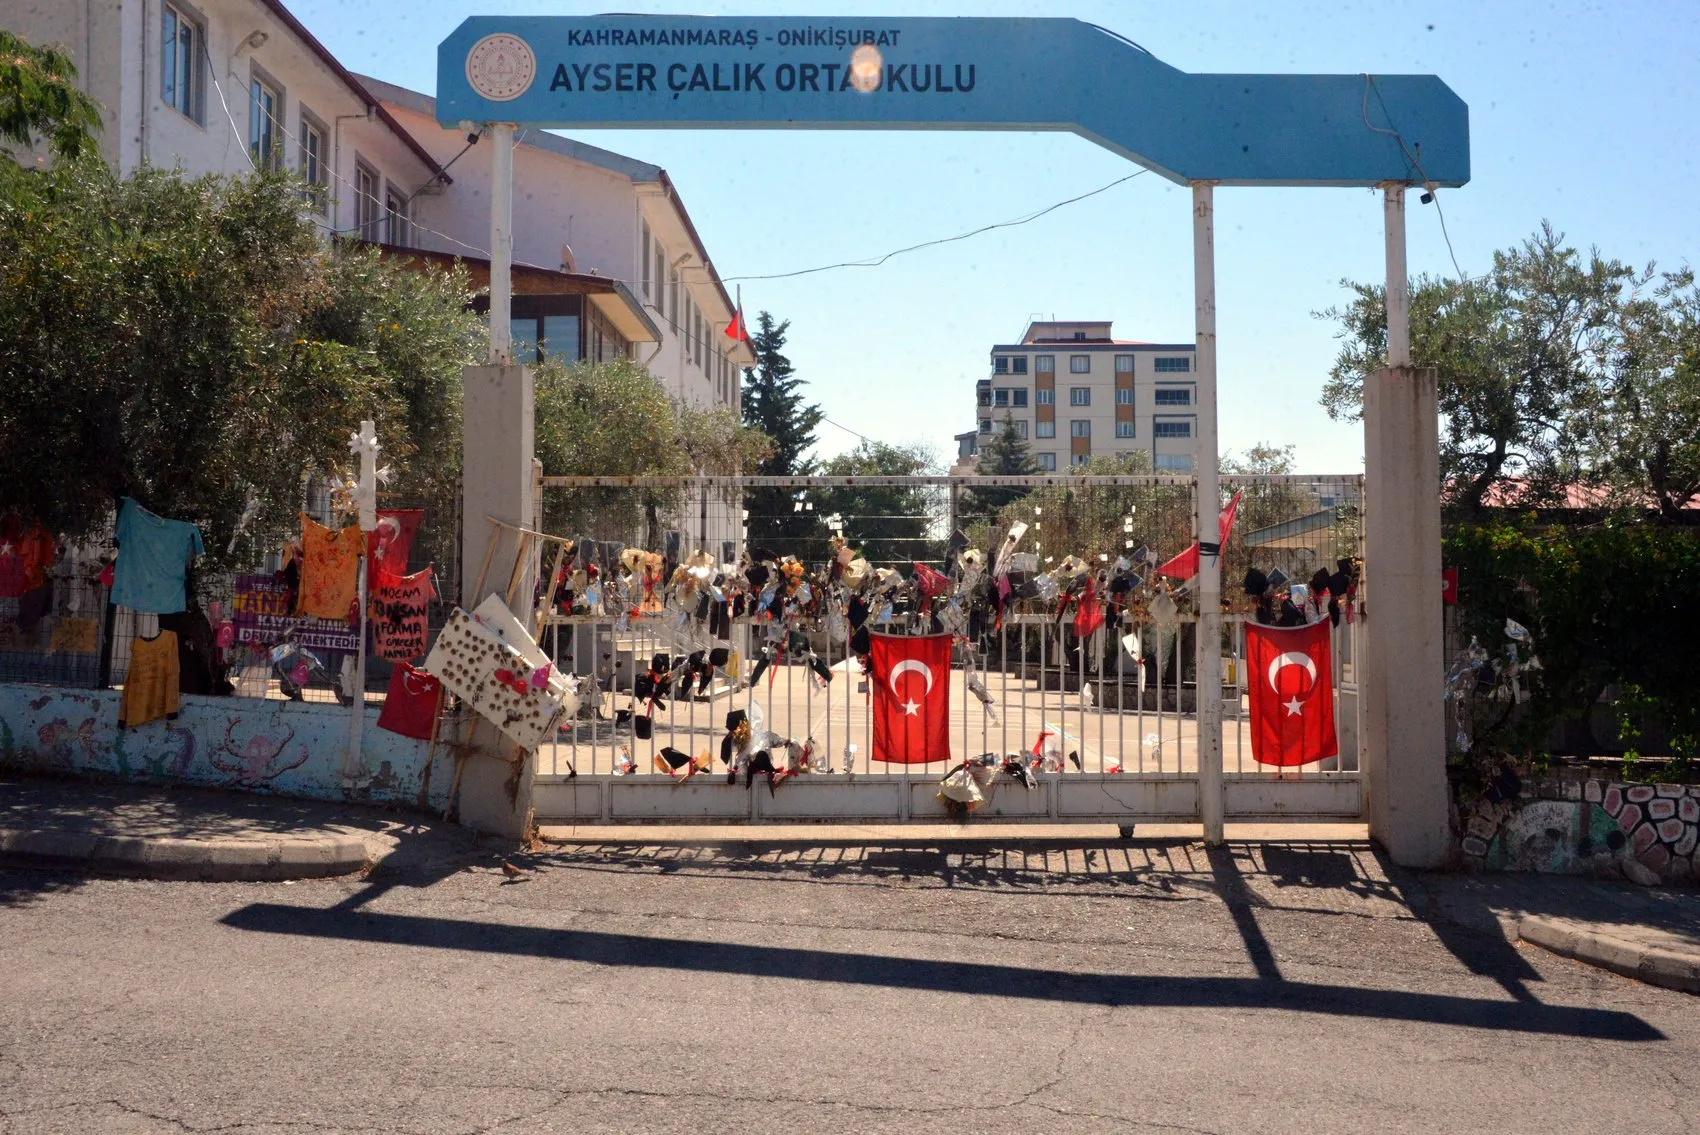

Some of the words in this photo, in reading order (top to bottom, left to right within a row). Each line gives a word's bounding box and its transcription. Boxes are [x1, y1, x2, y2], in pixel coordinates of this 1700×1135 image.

[567, 29, 759, 50] KAHRAMANMARAŞ
[777, 25, 901, 50] ONİKİŞUBAT
[549, 62, 657, 92] AYSER
[667, 62, 767, 100] ÇALIK
[381, 621, 422, 636] FORMA
